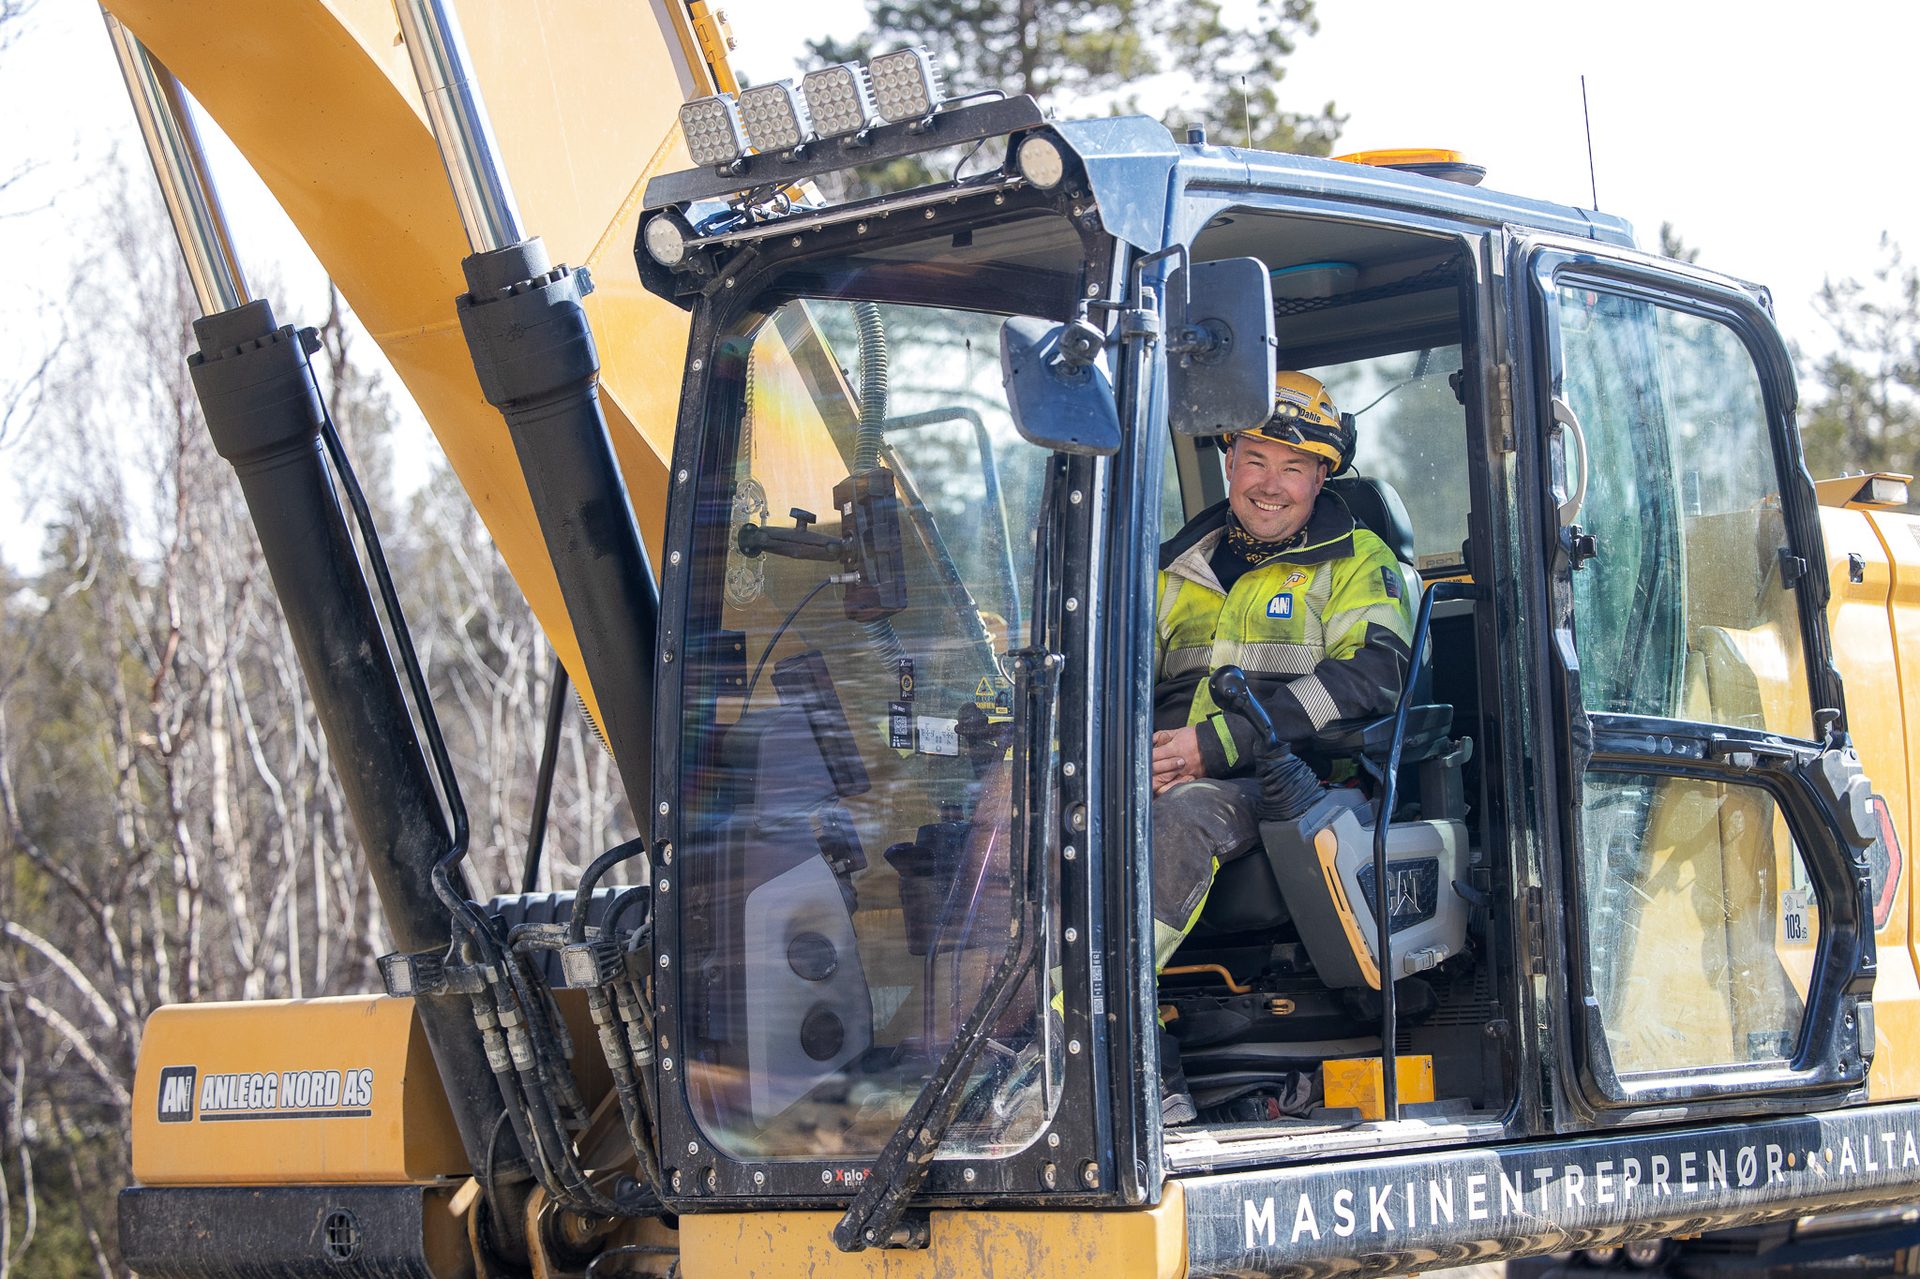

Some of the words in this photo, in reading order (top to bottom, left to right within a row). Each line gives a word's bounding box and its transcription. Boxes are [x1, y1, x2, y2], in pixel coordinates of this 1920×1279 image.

[1300, 408, 1321, 423] Dahle
[1269, 596, 1290, 615] AN
[1785, 913, 1801, 939] 103
[161, 1075, 193, 1113] AN
[200, 1072, 279, 1111] ANLEGG
[280, 1069, 342, 1109] NORD
[343, 1067, 374, 1107] AS
[1244, 1143, 1785, 1249] MASKINENTREPRENØR
[1840, 1130, 1920, 1175] ALTA
